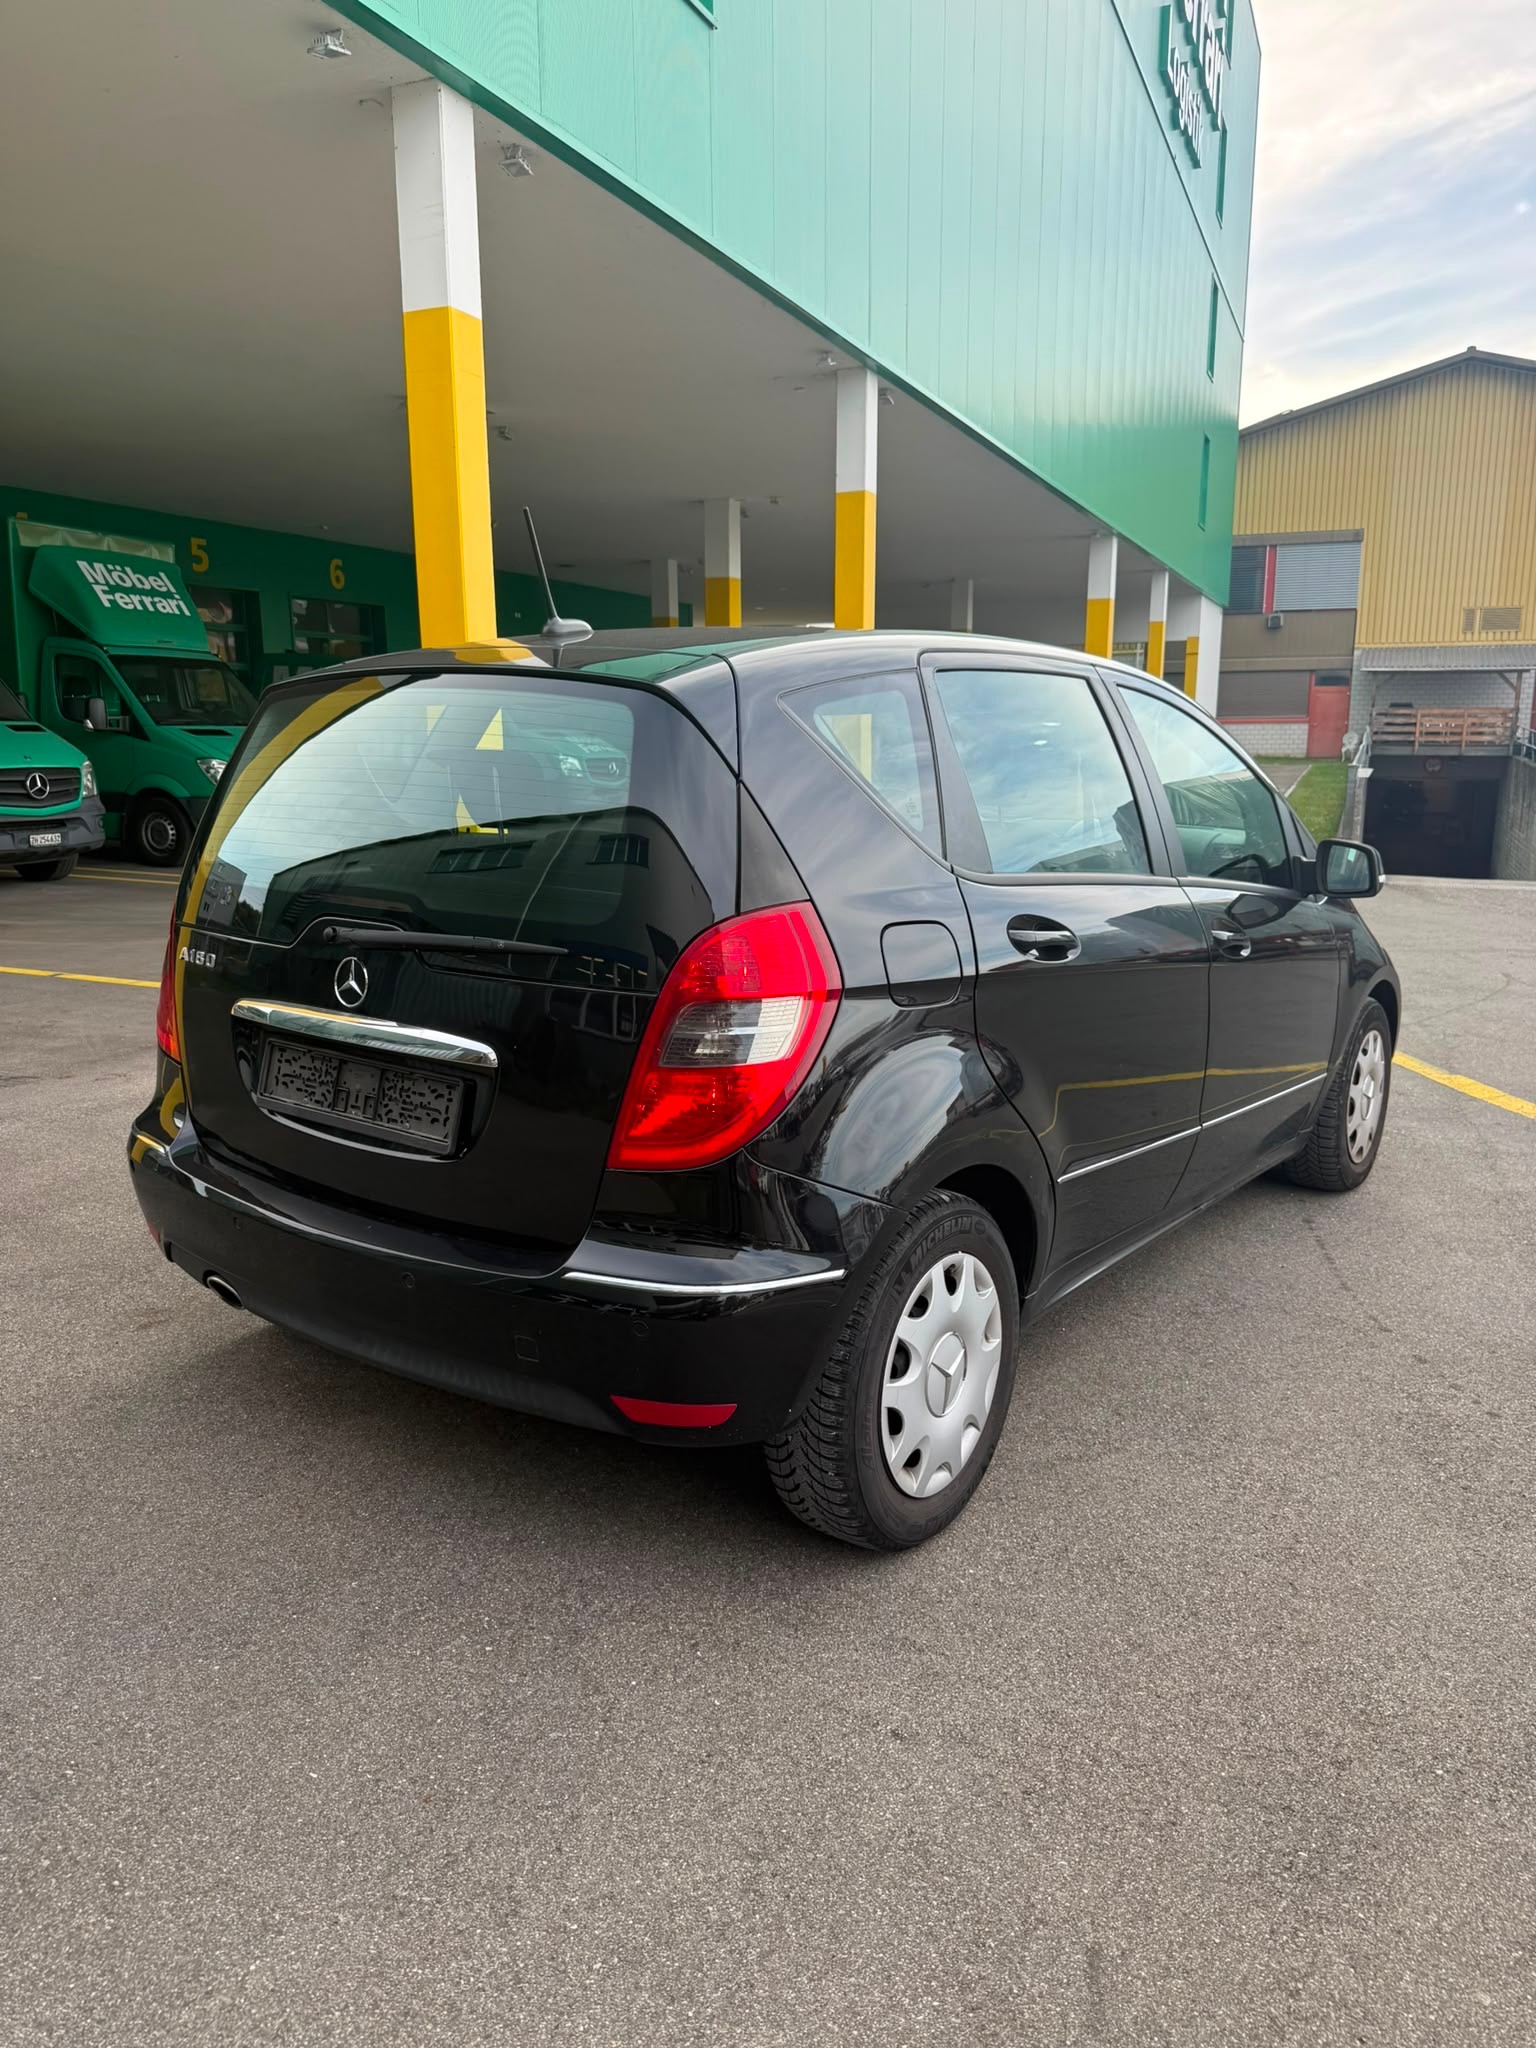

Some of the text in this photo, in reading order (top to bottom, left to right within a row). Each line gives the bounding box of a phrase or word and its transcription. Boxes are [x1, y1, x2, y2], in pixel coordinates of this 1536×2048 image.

[190, 537, 209, 572] 5
[76, 559, 177, 594] Möbel
[329, 558, 345, 590] 6
[92, 584, 191, 617] Ferrari
[909, 1215, 973, 1269] MICHELIN
